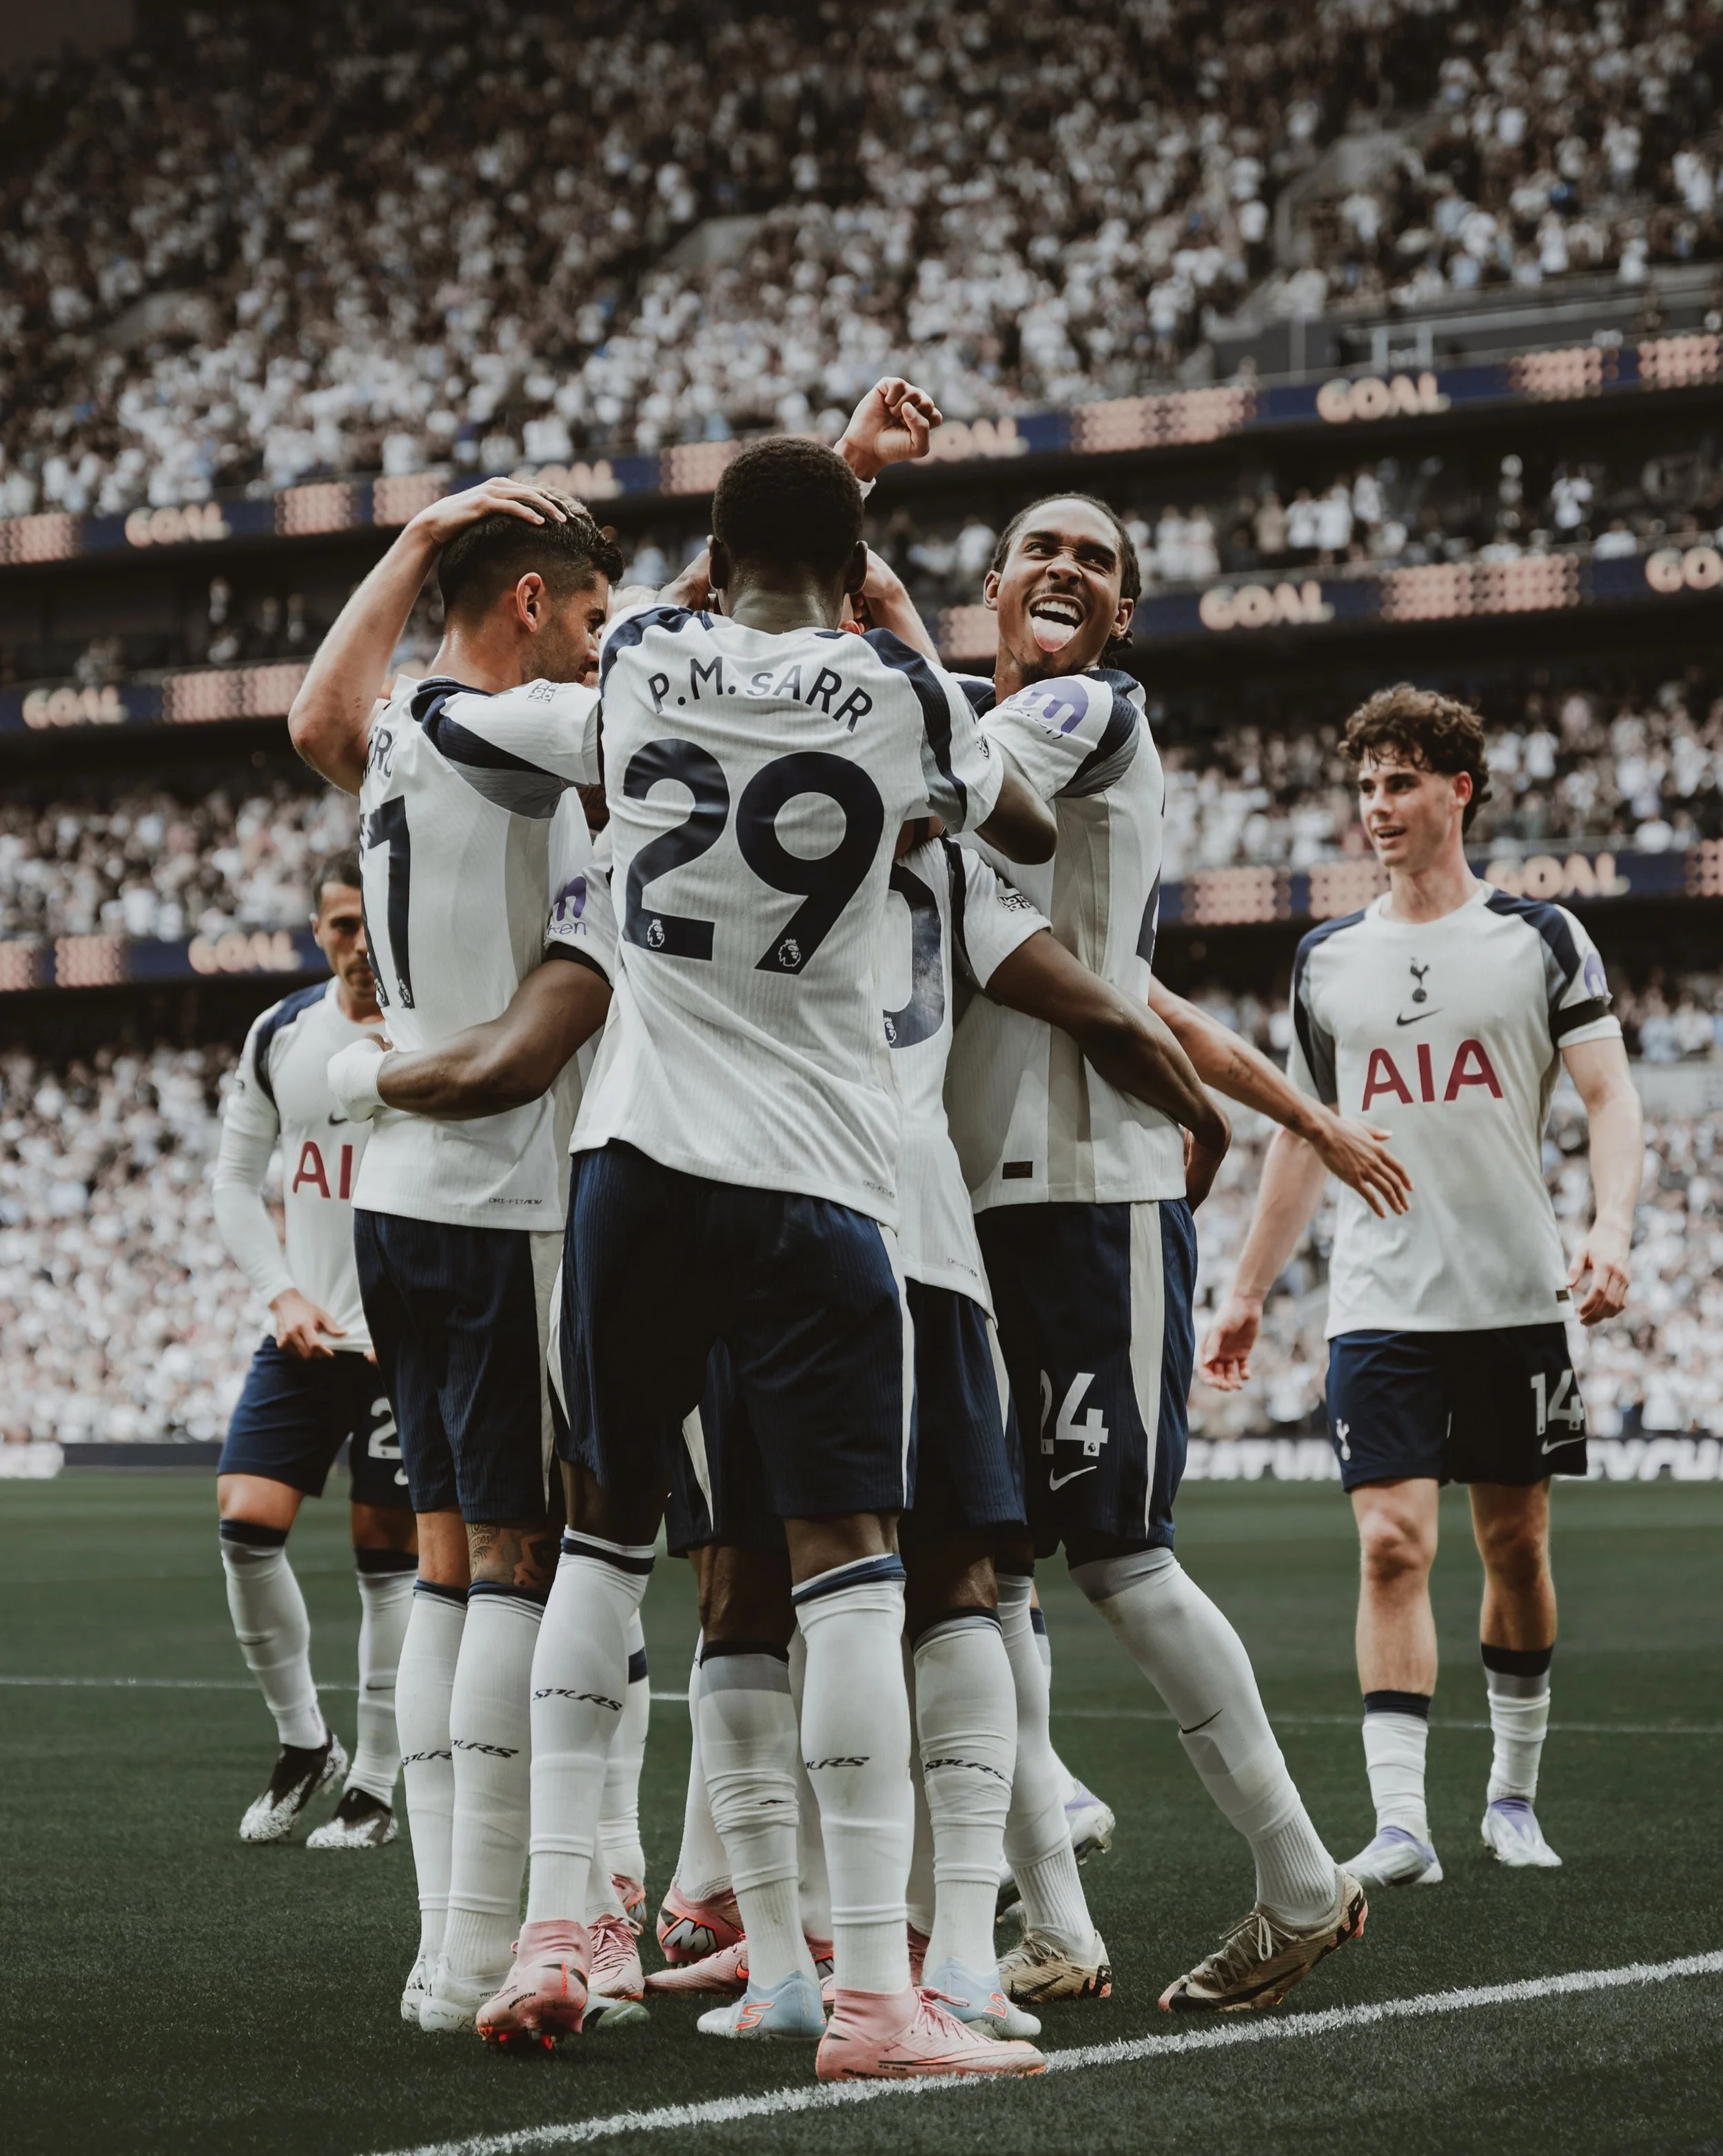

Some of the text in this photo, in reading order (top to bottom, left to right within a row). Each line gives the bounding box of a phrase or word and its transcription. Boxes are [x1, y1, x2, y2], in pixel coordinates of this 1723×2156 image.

[1317, 372, 1451, 423] GOAL
[910, 415, 1030, 465] OAL
[125, 502, 232, 547] GOAL
[1645, 547, 1723, 593] GO
[1199, 580, 1336, 631] GOAL
[22, 684, 129, 729] GOAL
[622, 738, 884, 975] 29
[1485, 852, 1631, 900] GOAL
[1362, 1039, 1504, 1112] AIA
[292, 1141, 352, 1200] AI
[1531, 1369, 1585, 1436] 14
[533, 1689, 622, 1711] SPURS
